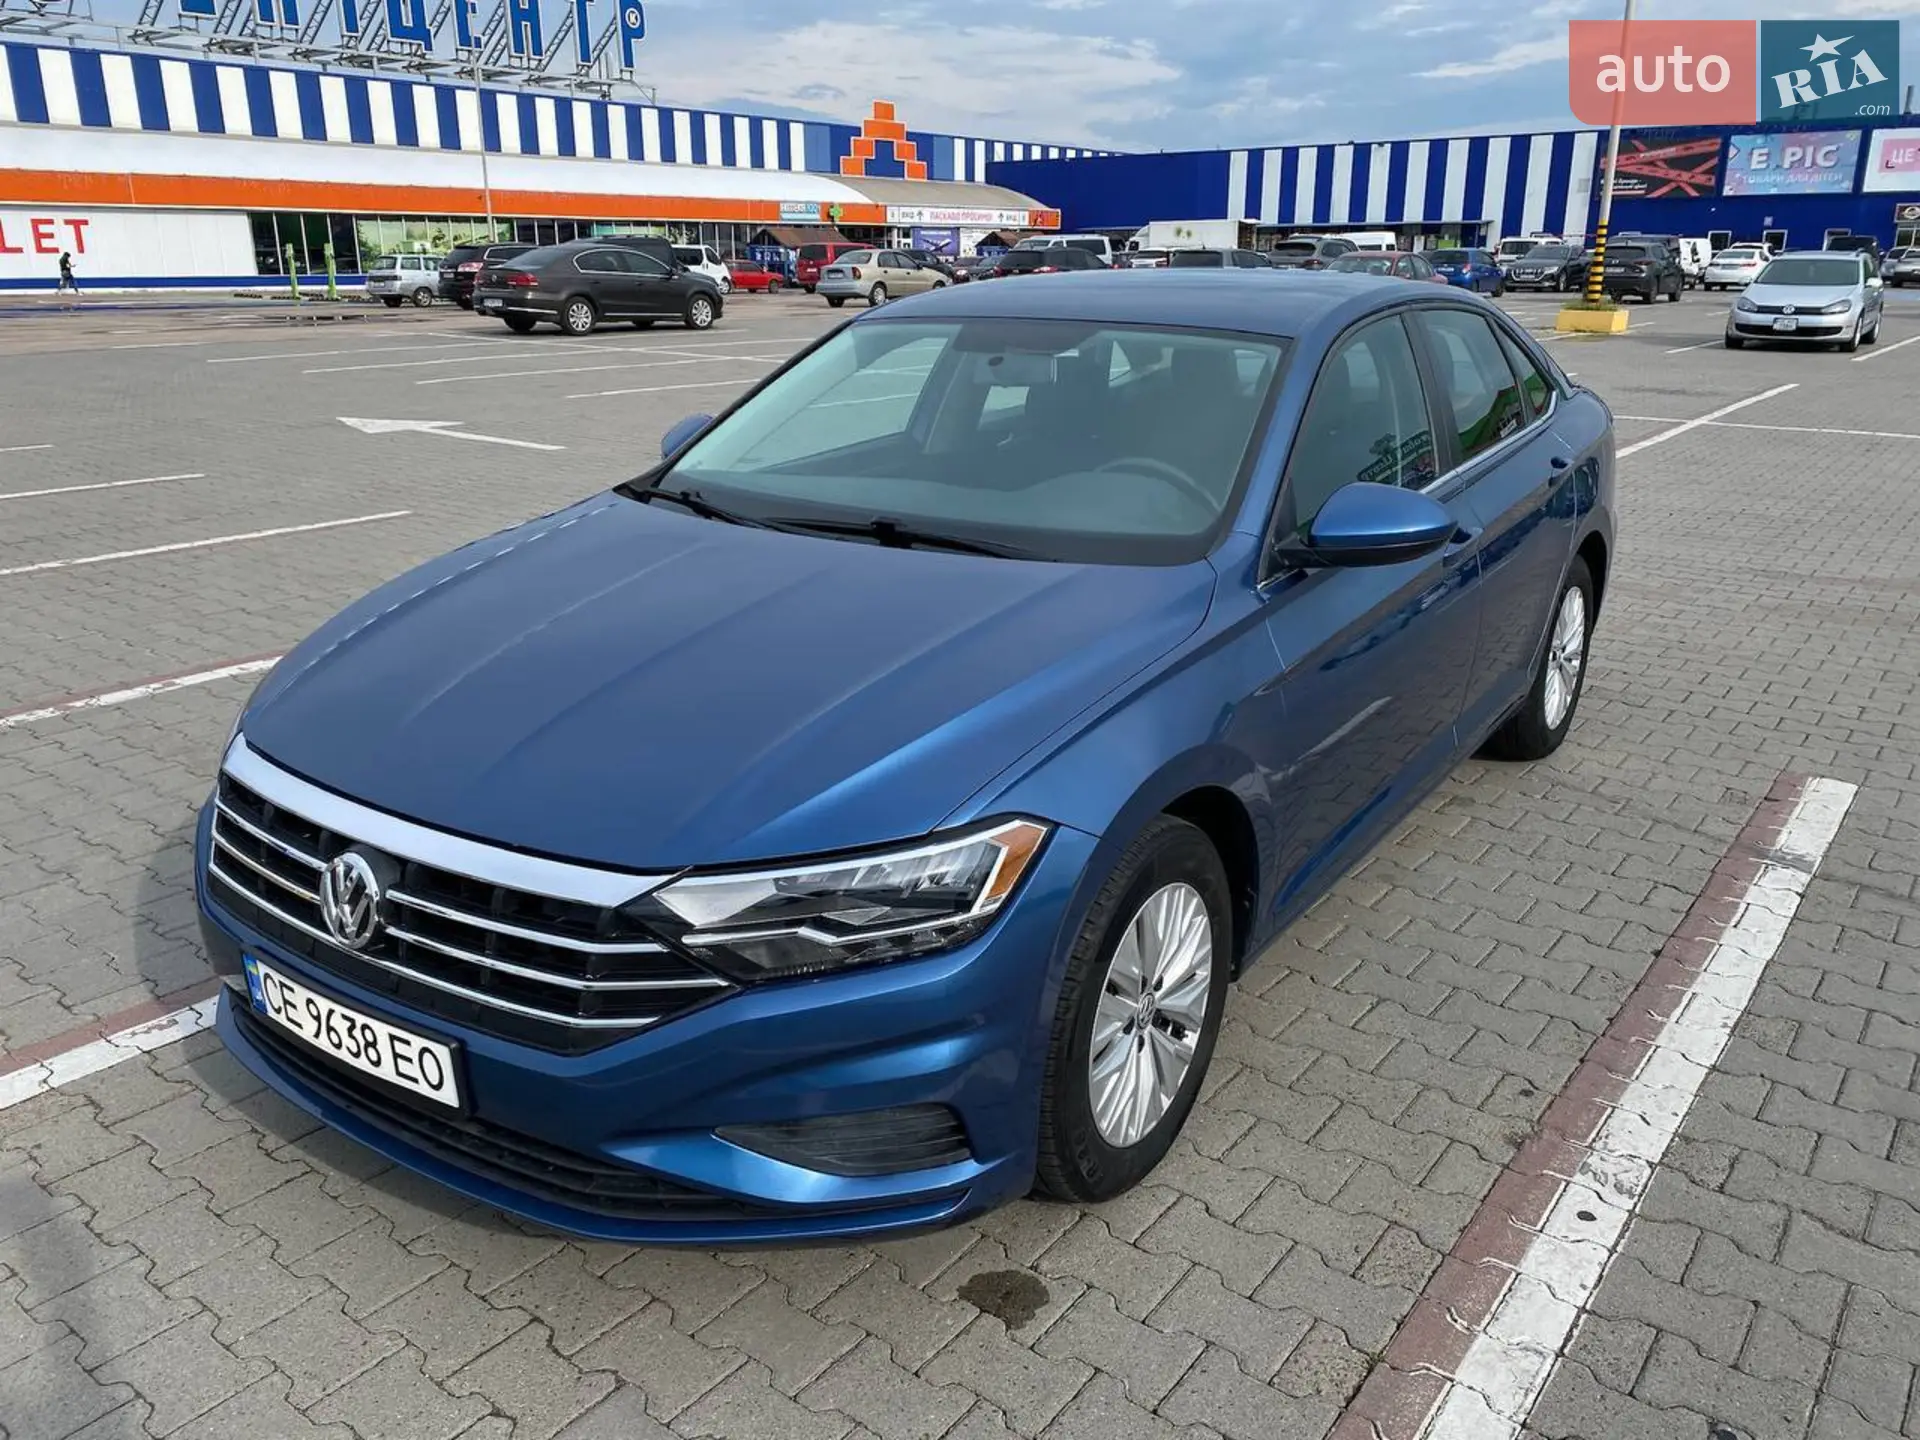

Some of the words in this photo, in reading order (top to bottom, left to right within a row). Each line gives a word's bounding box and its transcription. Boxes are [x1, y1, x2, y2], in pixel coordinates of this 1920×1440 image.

[0, 218, 89, 254] LET
[263, 972, 304, 1030] CE
[306, 997, 382, 1068] 9638
[388, 1032, 444, 1092] EO
